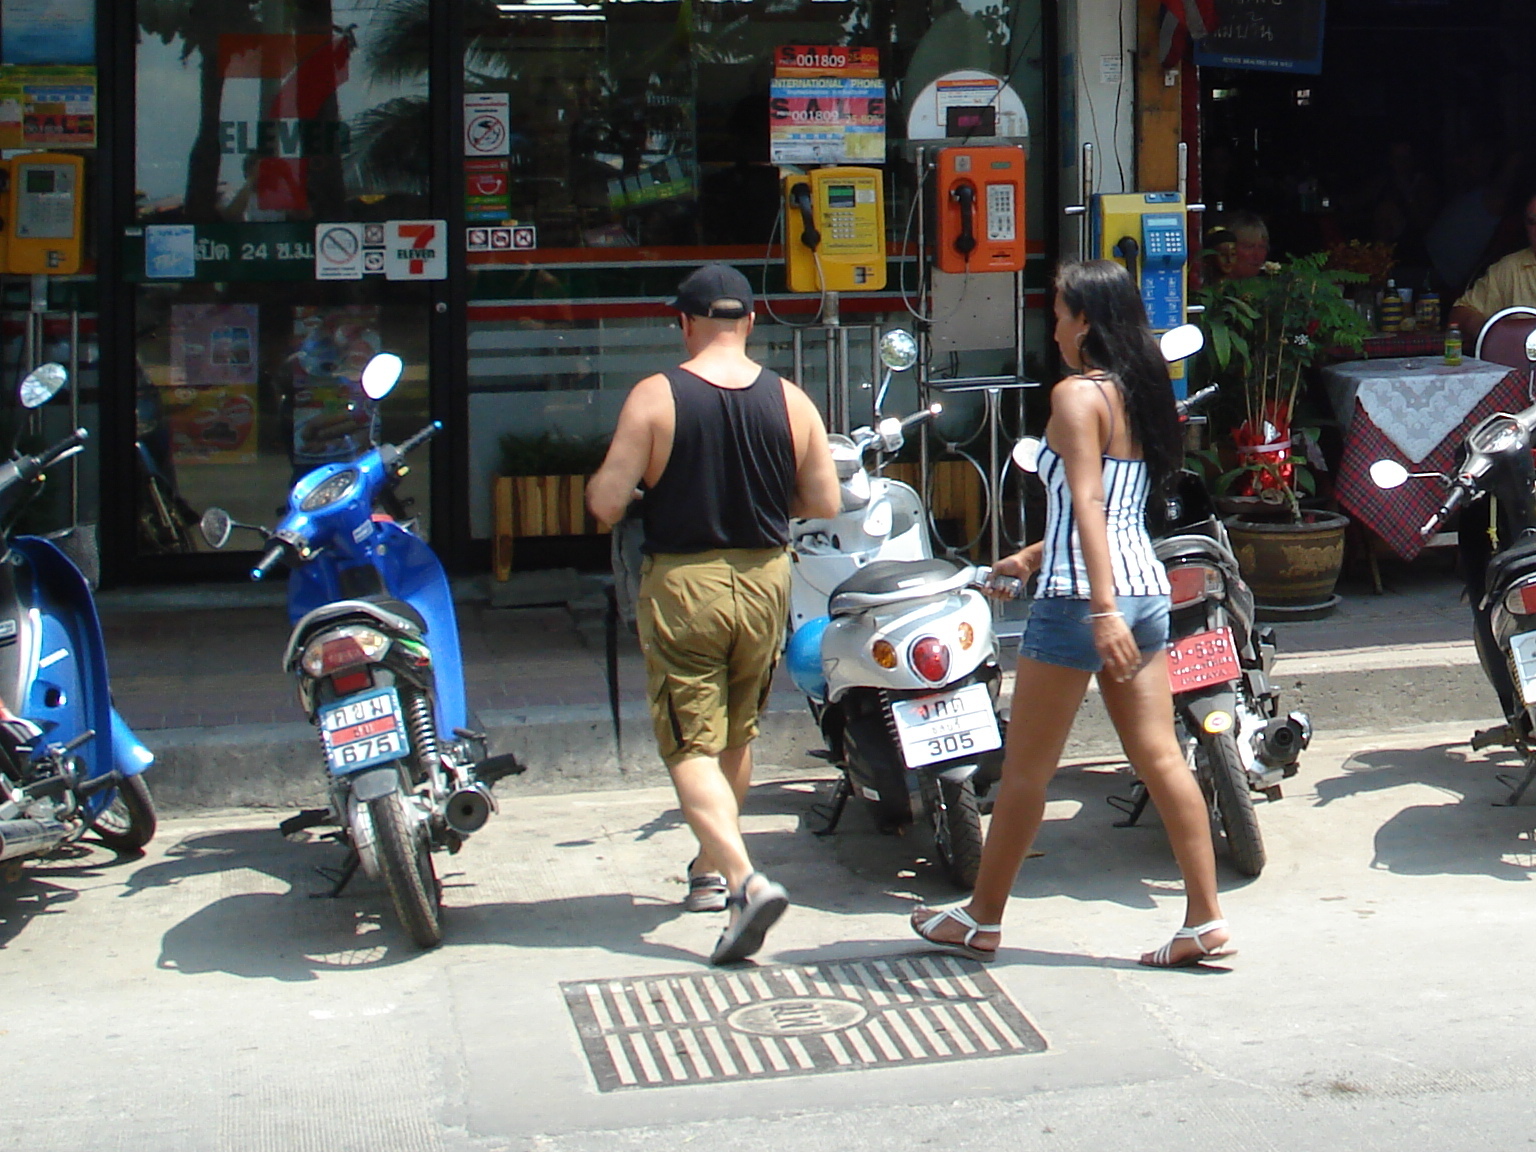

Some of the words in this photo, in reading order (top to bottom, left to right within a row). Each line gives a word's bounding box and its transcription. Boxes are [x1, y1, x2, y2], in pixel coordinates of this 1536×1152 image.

[796, 54, 846, 67] 001809
[771, 79, 844, 88] INTERNATIONAL
[850, 79, 884, 88] PHONE
[792, 110, 839, 121] 001809
[241, 243, 267, 260] 24
[342, 735, 392, 763] 675
[928, 731, 974, 756] 305
